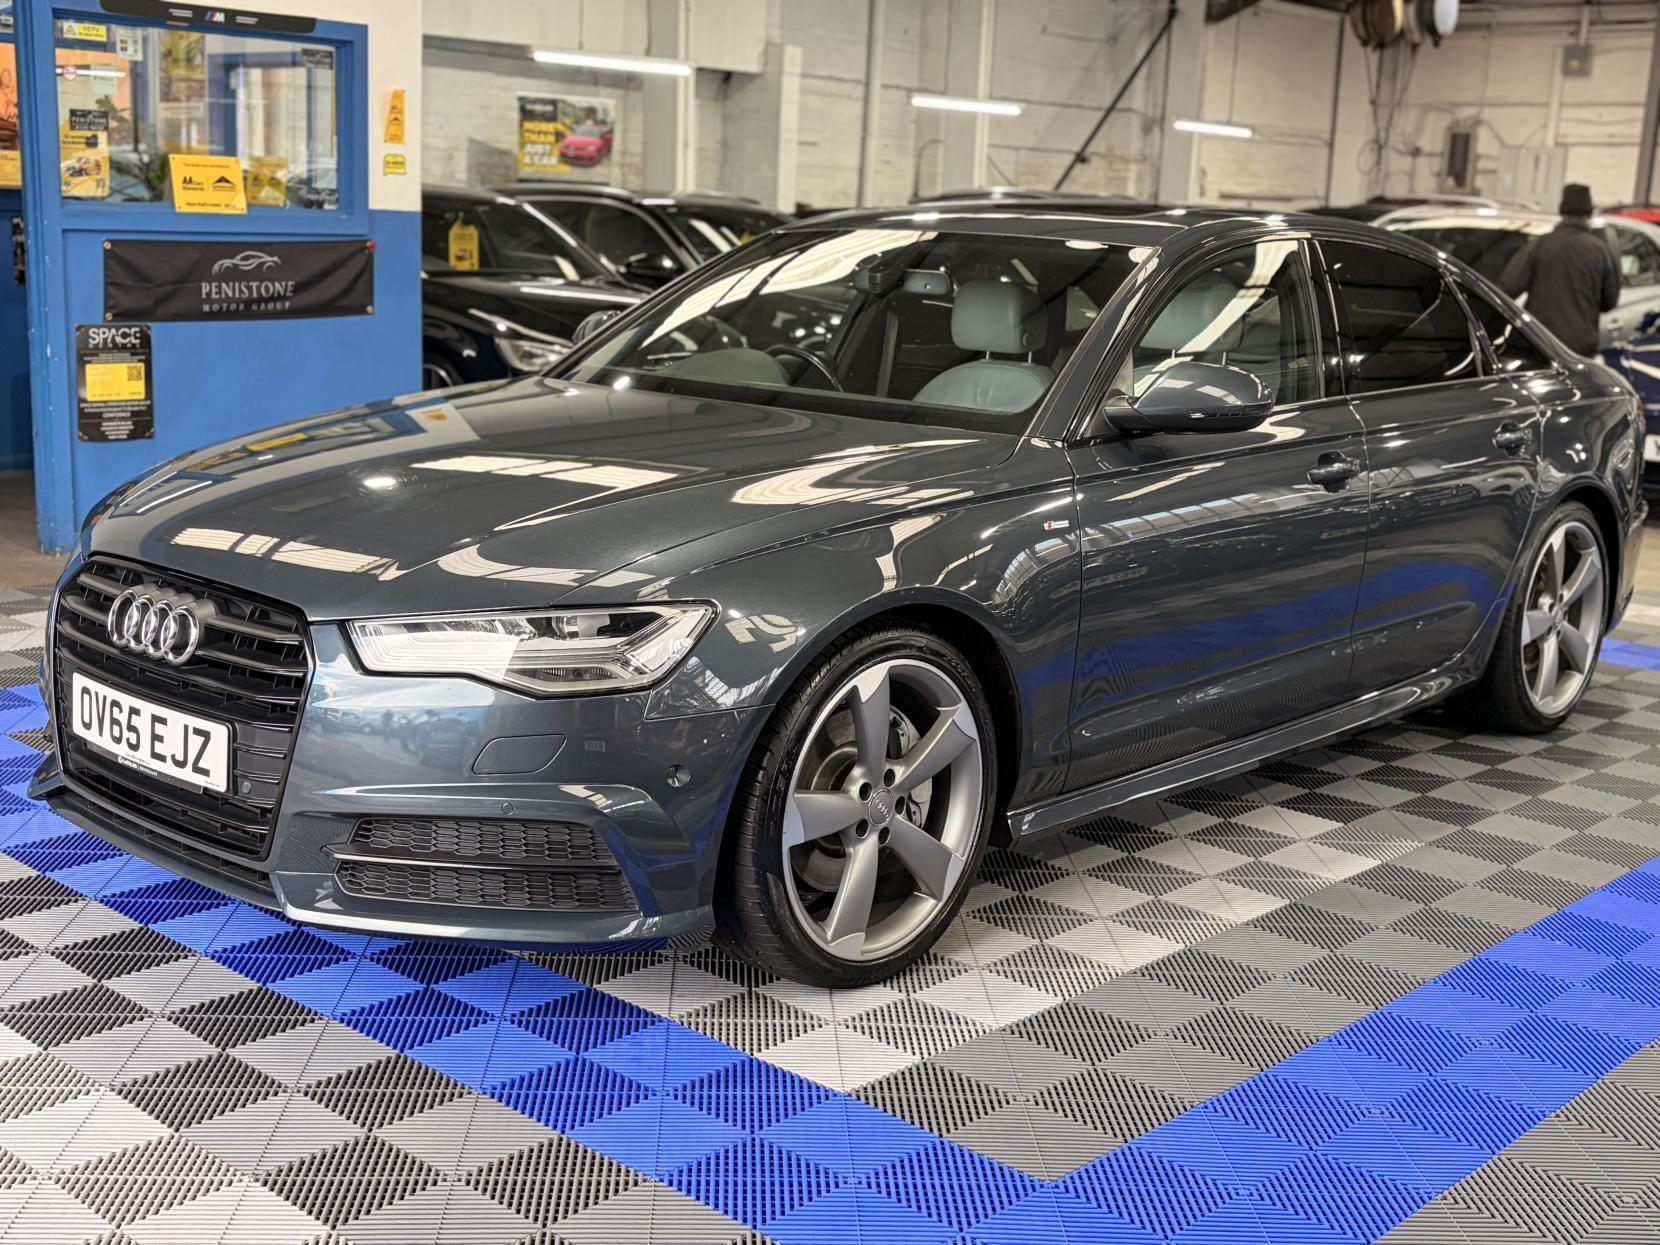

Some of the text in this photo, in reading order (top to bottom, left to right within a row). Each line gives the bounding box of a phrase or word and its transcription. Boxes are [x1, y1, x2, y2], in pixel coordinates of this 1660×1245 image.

[82, 25, 101, 33] CCTV
[201, 281, 295, 299] PENISTONE
[202, 301, 291, 313] MOTOR GROUP
[88, 327, 141, 344] SPACE
[80, 685, 212, 778] OV65 EJZ
